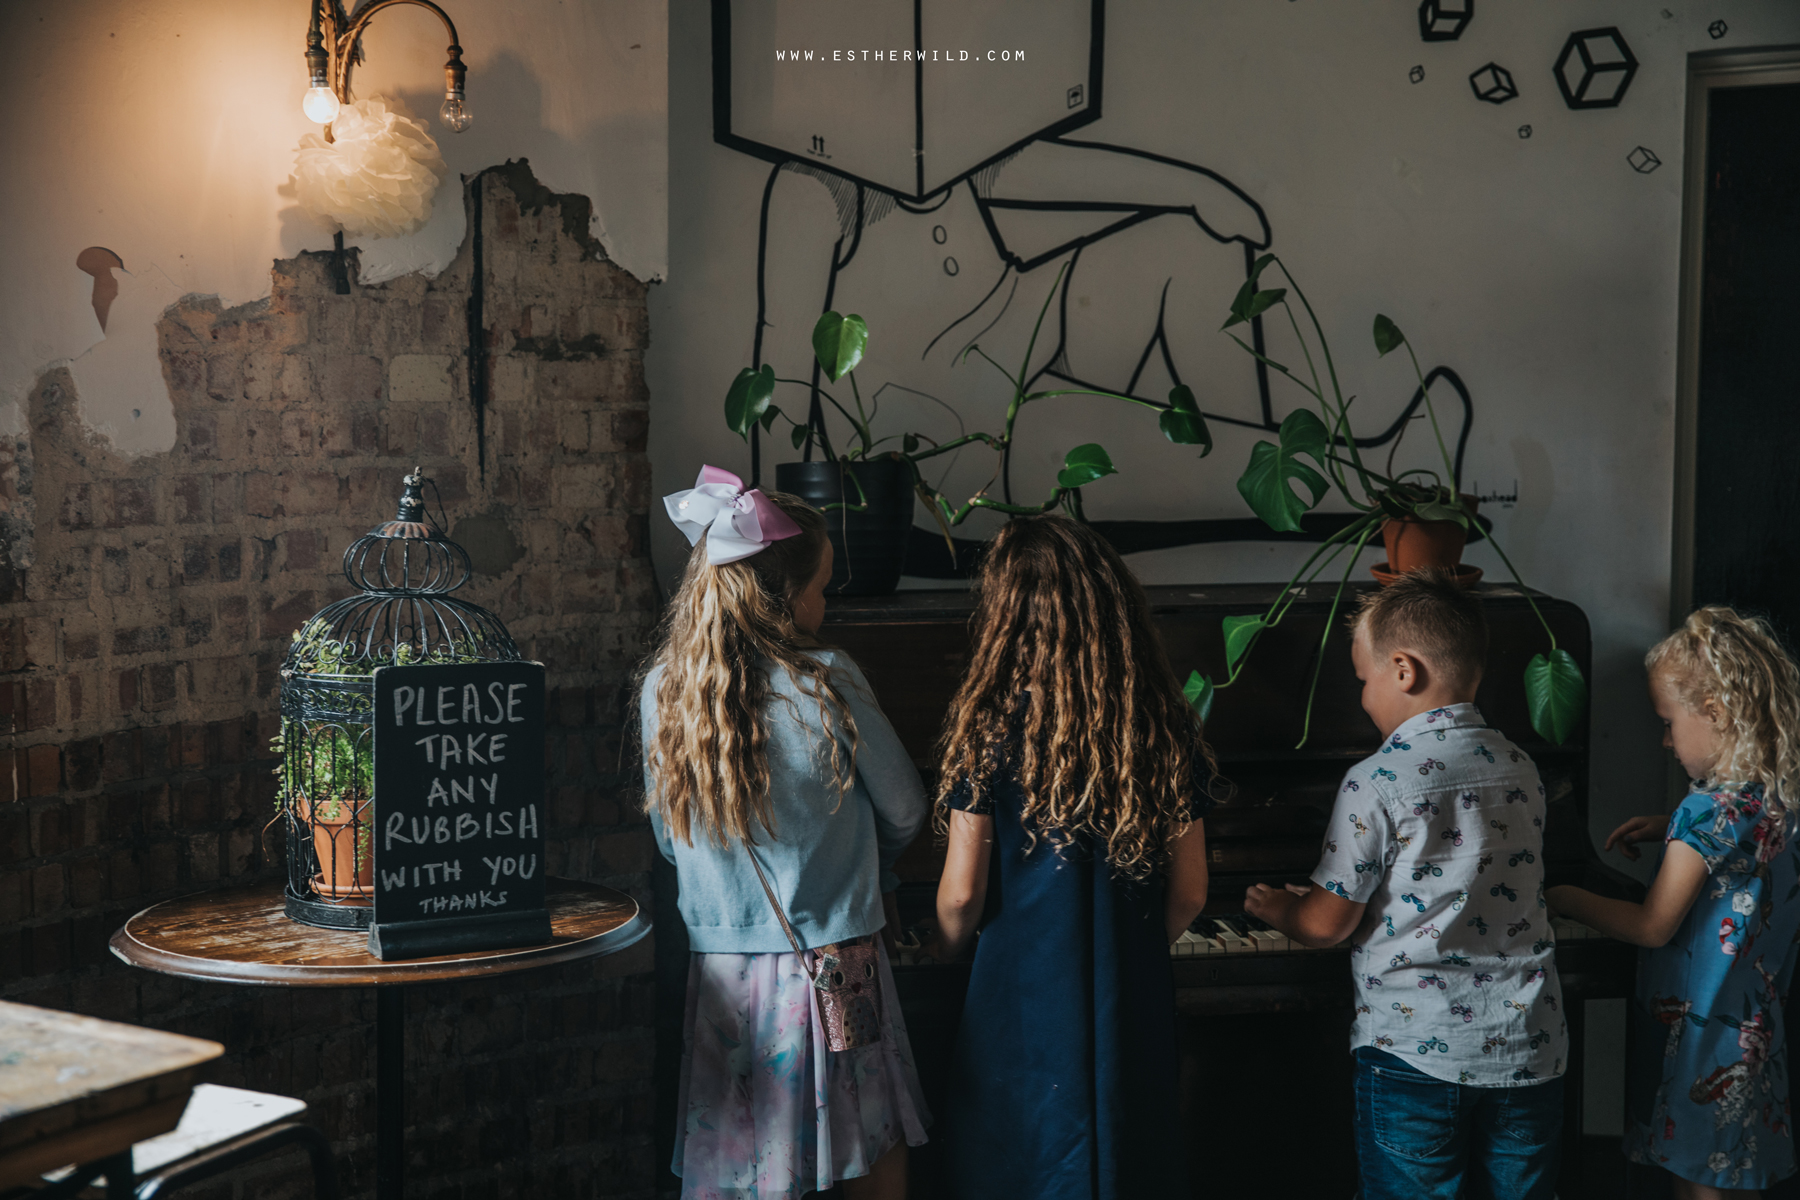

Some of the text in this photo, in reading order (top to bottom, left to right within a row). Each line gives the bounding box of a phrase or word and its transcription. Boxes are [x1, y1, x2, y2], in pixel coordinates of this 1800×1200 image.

[393, 681, 528, 727] PLEASE
[415, 732, 509, 771] TAKE
[427, 773, 498, 808] ANY
[385, 803, 539, 851] RUBBISH
[381, 853, 537, 892] WITH YOU
[418, 890, 508, 914] THANKS
